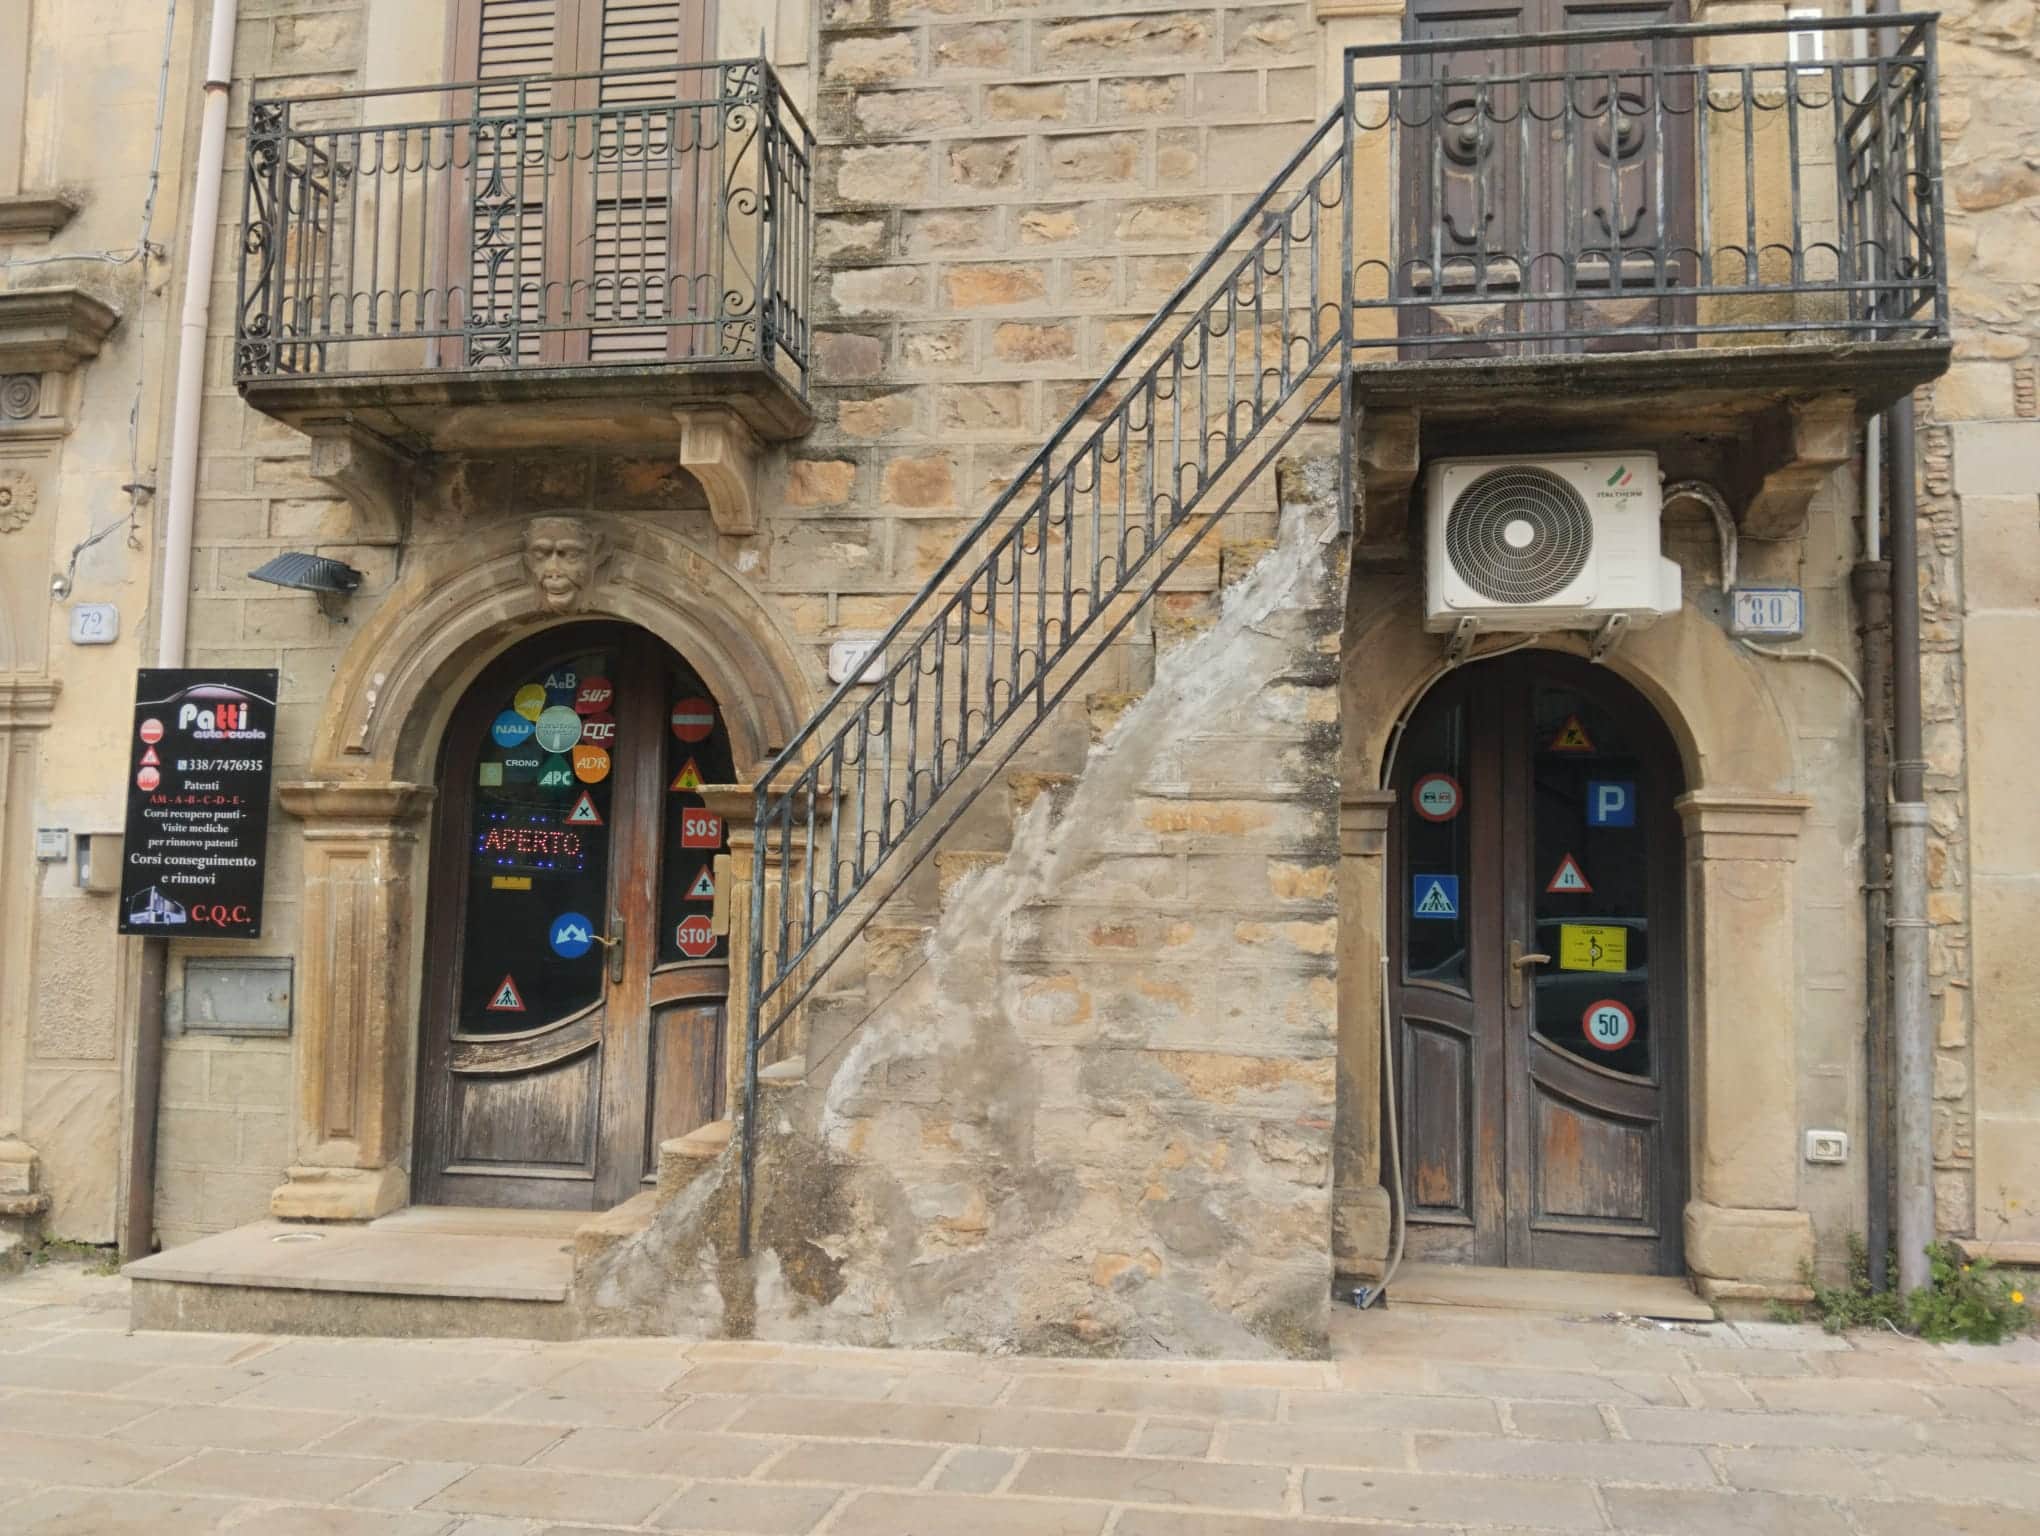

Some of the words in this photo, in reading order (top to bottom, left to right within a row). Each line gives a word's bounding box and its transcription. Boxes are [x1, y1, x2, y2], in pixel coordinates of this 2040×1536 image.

[1751, 598, 1783, 625] 80
[80, 612, 103, 635] 72
[577, 689, 612, 702] SUP
[178, 703, 249, 730] Patti
[582, 723, 616, 739] CQC
[189, 759, 264, 771] 338/7476935
[505, 759, 539, 768] CRONO
[576, 757, 608, 769] ADR
[184, 780, 220, 791] Patenti
[539, 770, 572, 786] APC
[1598, 786, 1625, 822] P
[144, 808, 168, 819] Corsi
[170, 811, 213, 821] recupero
[213, 810, 240, 822] punti
[161, 823, 187, 833] Visite
[188, 823, 229, 833] mediche
[685, 818, 718, 837] SOS
[148, 838, 165, 849] per
[165, 837, 203, 848] rinnovo
[204, 838, 239, 850] patenti
[485, 828, 580, 855] APERTO
[130, 852, 162, 865] Corsi
[164, 854, 257, 870] conseguimento
[161, 874, 169, 884] e
[171, 872, 217, 885] rinnovi
[191, 904, 252, 927] C.Q.C.
[680, 928, 712, 944] STOP
[1598, 1013, 1619, 1036] 50
